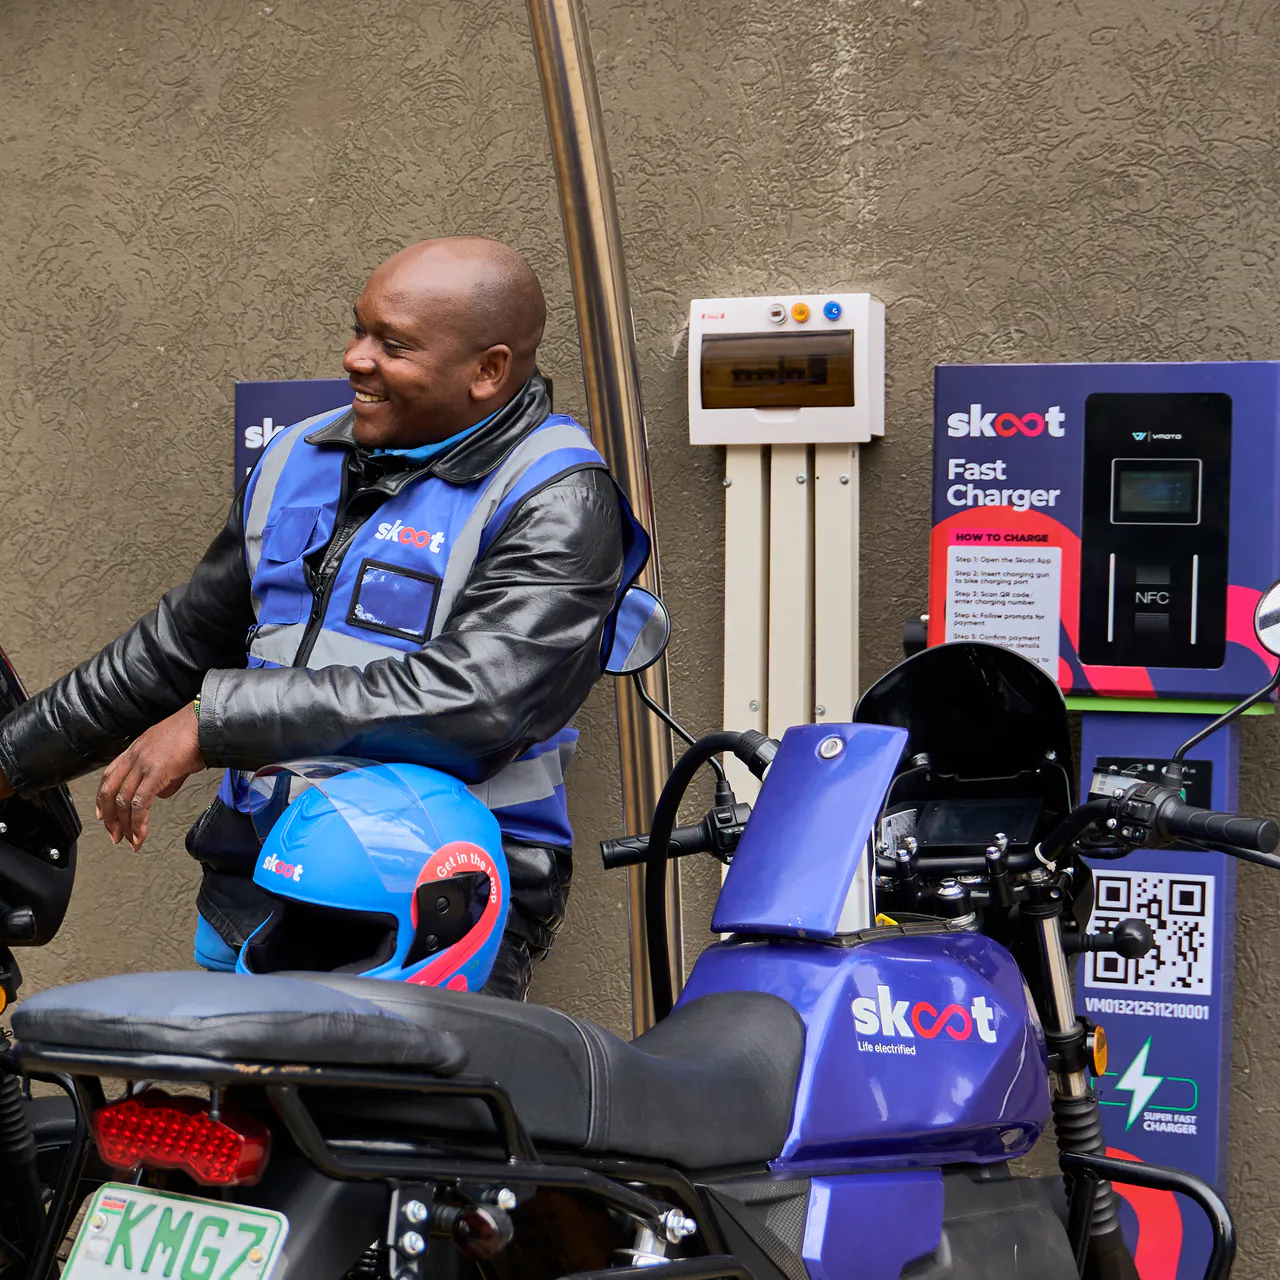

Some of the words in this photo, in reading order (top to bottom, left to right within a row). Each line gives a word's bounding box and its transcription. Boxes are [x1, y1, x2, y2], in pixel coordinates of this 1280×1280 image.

[947, 404, 1065, 437] skoot
[948, 459, 1007, 480] Fast
[946, 484, 1061, 512] Charger
[374, 519, 445, 554] skoot
[956, 533, 983, 542] HOW
[986, 533, 1001, 542] TO
[1004, 534, 1048, 542] CHARGE
[980, 556, 1000, 564] Open
[1135, 591, 1169, 604] NFC
[262, 853, 303, 882] skoot
[436, 856, 456, 877] Get
[455, 852, 468, 864] in
[470, 853, 486, 870] the
[851, 984, 997, 1043] skoot
[858, 1041, 873, 1052] Life
[875, 1043, 916, 1055] electrified
[1143, 1111, 1173, 1122] SUPER
[1174, 1114, 1197, 1124] FAST
[1143, 1121, 1197, 1135] CHARGER
